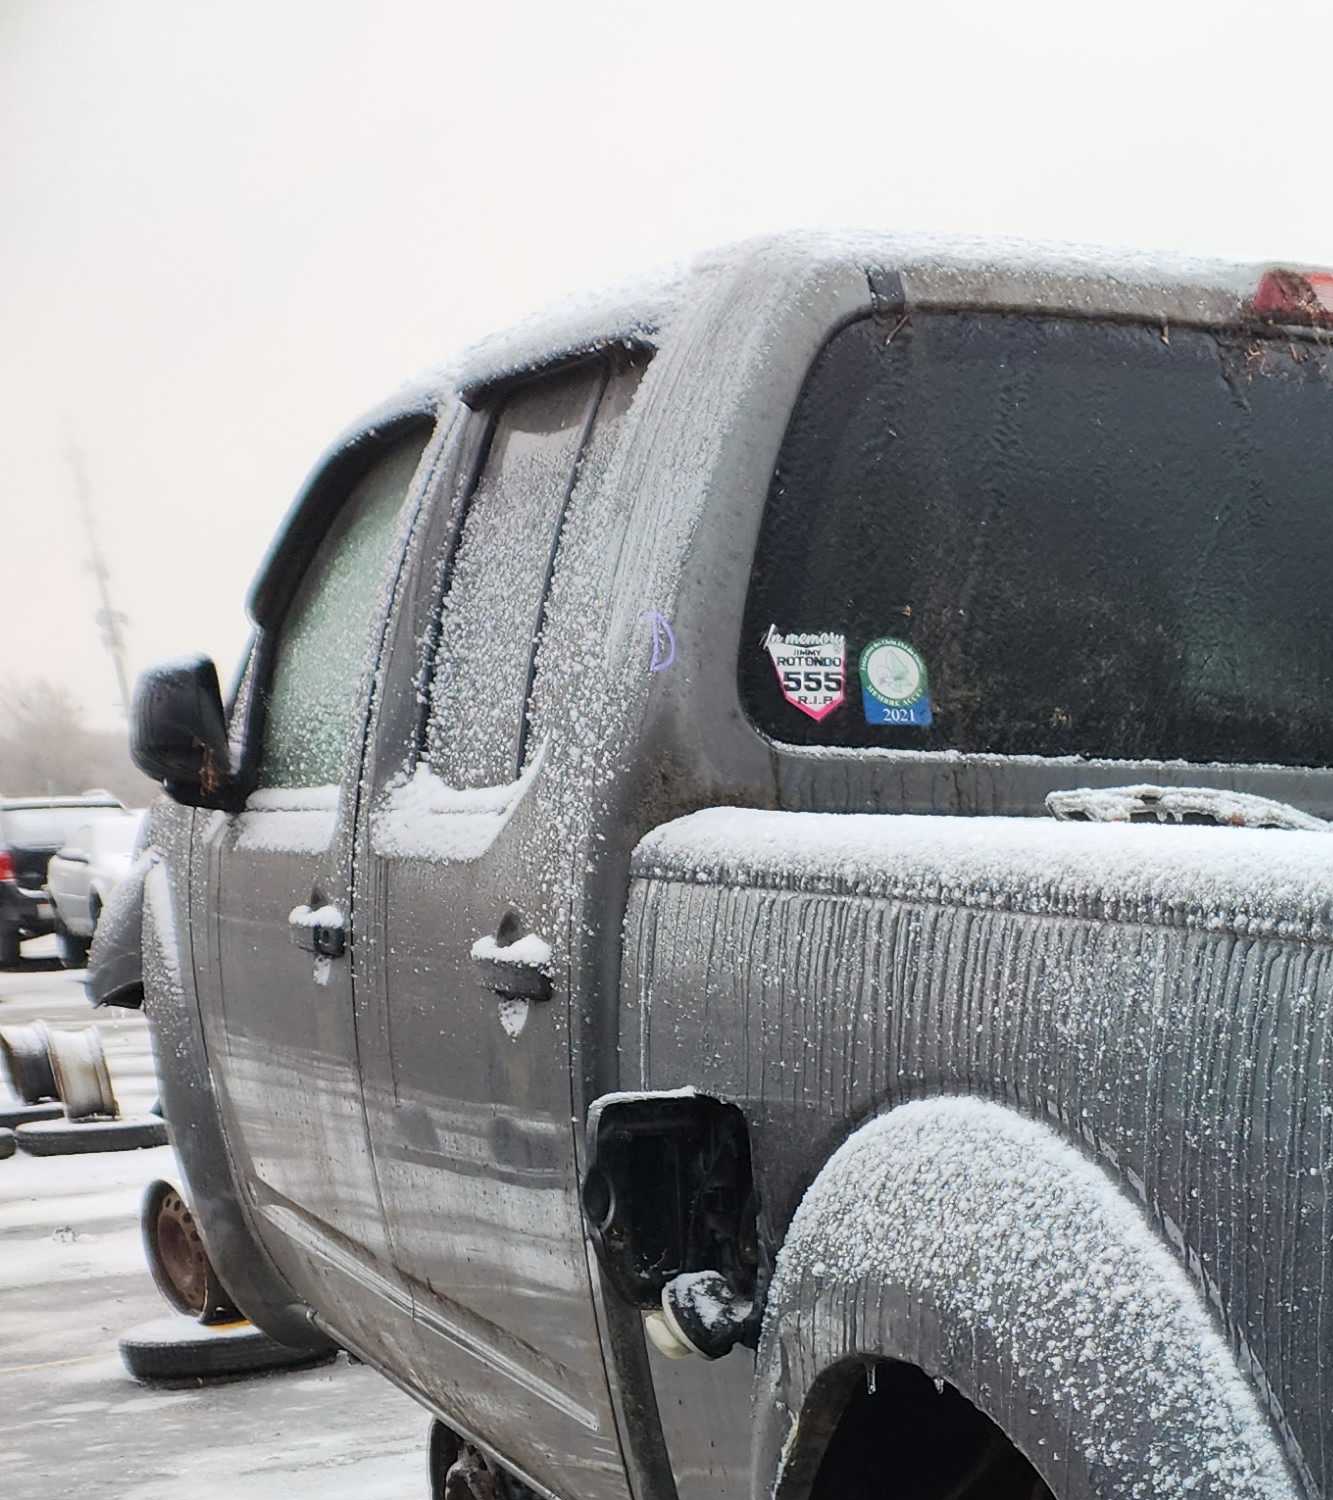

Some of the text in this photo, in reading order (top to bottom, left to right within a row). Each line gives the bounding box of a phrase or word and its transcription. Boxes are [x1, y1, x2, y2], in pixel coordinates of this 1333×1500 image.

[762, 623, 845, 650] In memory
[794, 648, 820, 656] JIMMY
[777, 656, 842, 667] ROTONDO
[783, 672, 843, 692] 555
[882, 708, 916, 722] 2021
